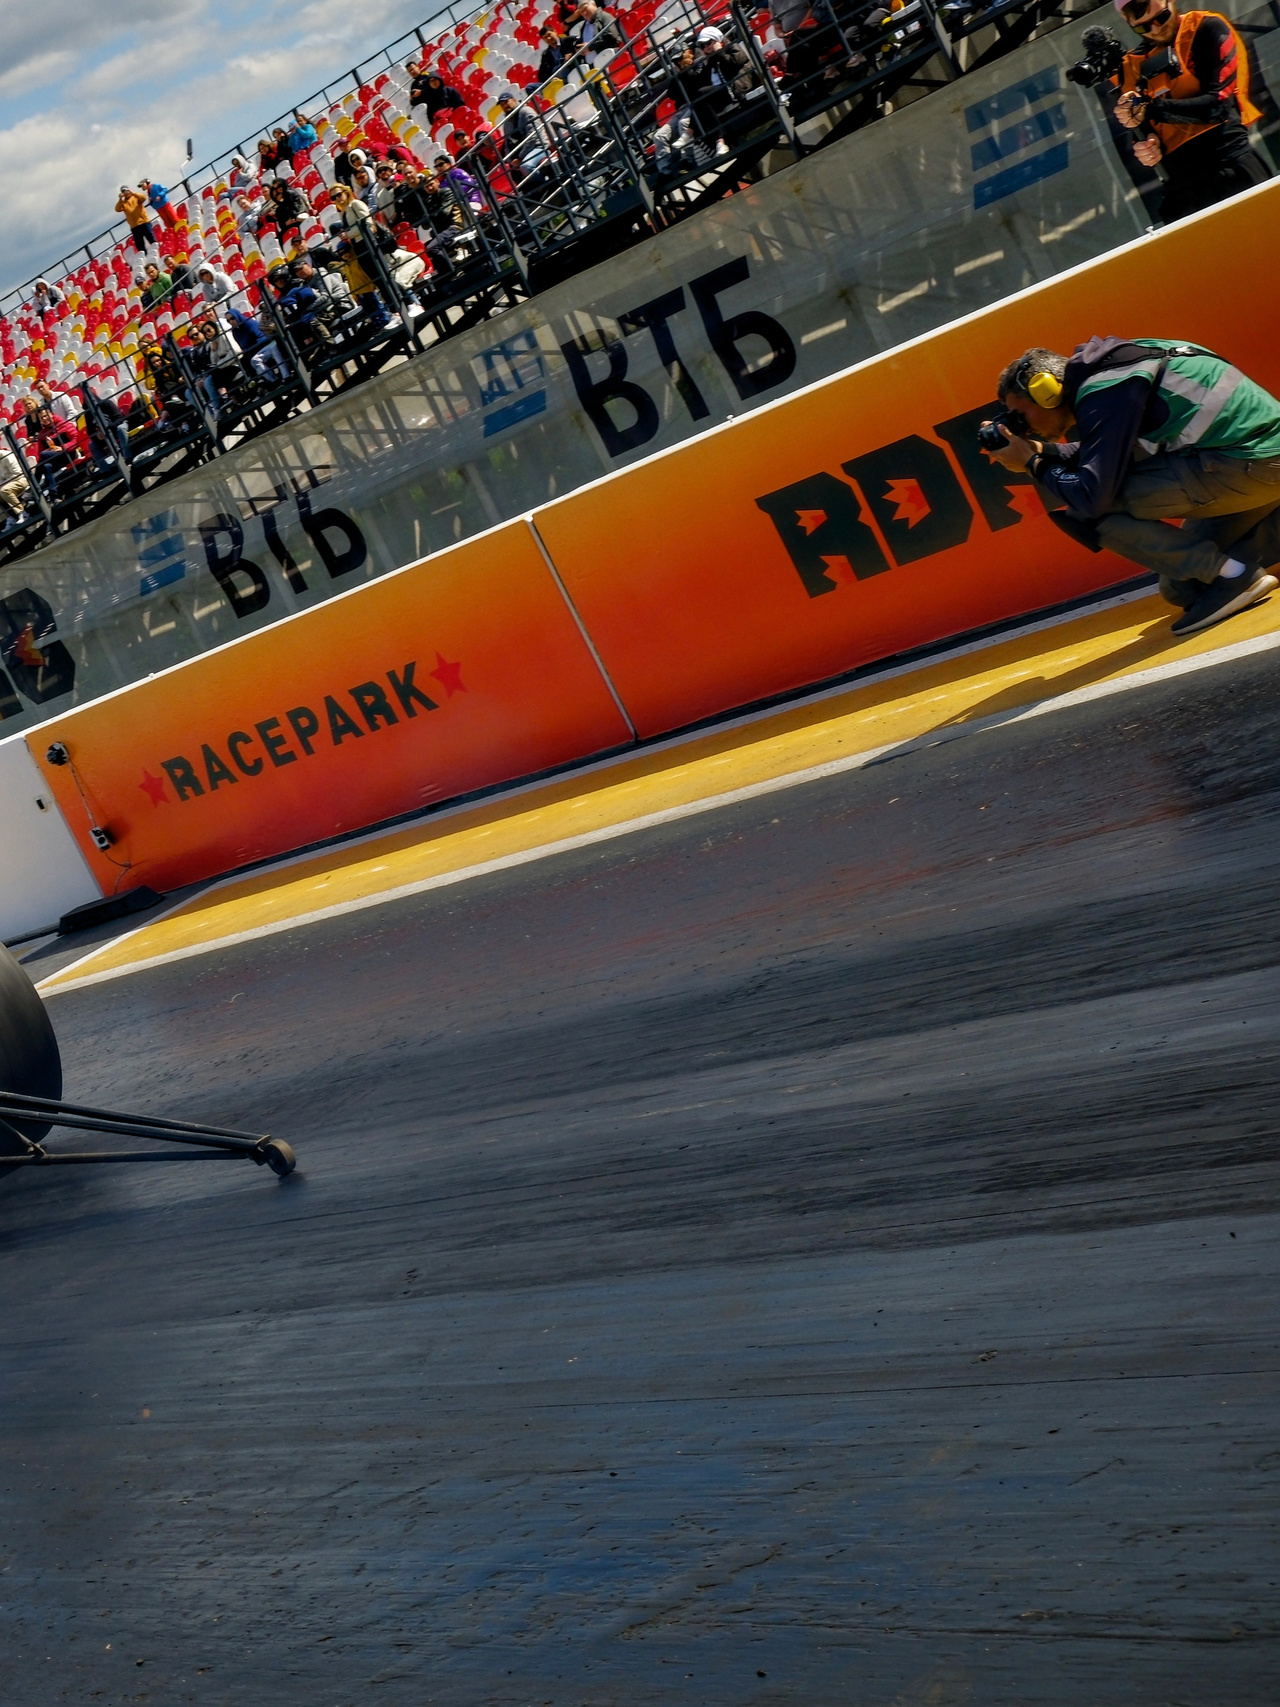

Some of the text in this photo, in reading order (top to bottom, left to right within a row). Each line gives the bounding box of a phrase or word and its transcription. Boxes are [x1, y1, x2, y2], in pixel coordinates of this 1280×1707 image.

[560, 255, 796, 458] ВТБ
[198, 466, 367, 618] ВТБ
[755, 398, 1074, 598] RDR
[160, 661, 440, 802] RACEPARK
